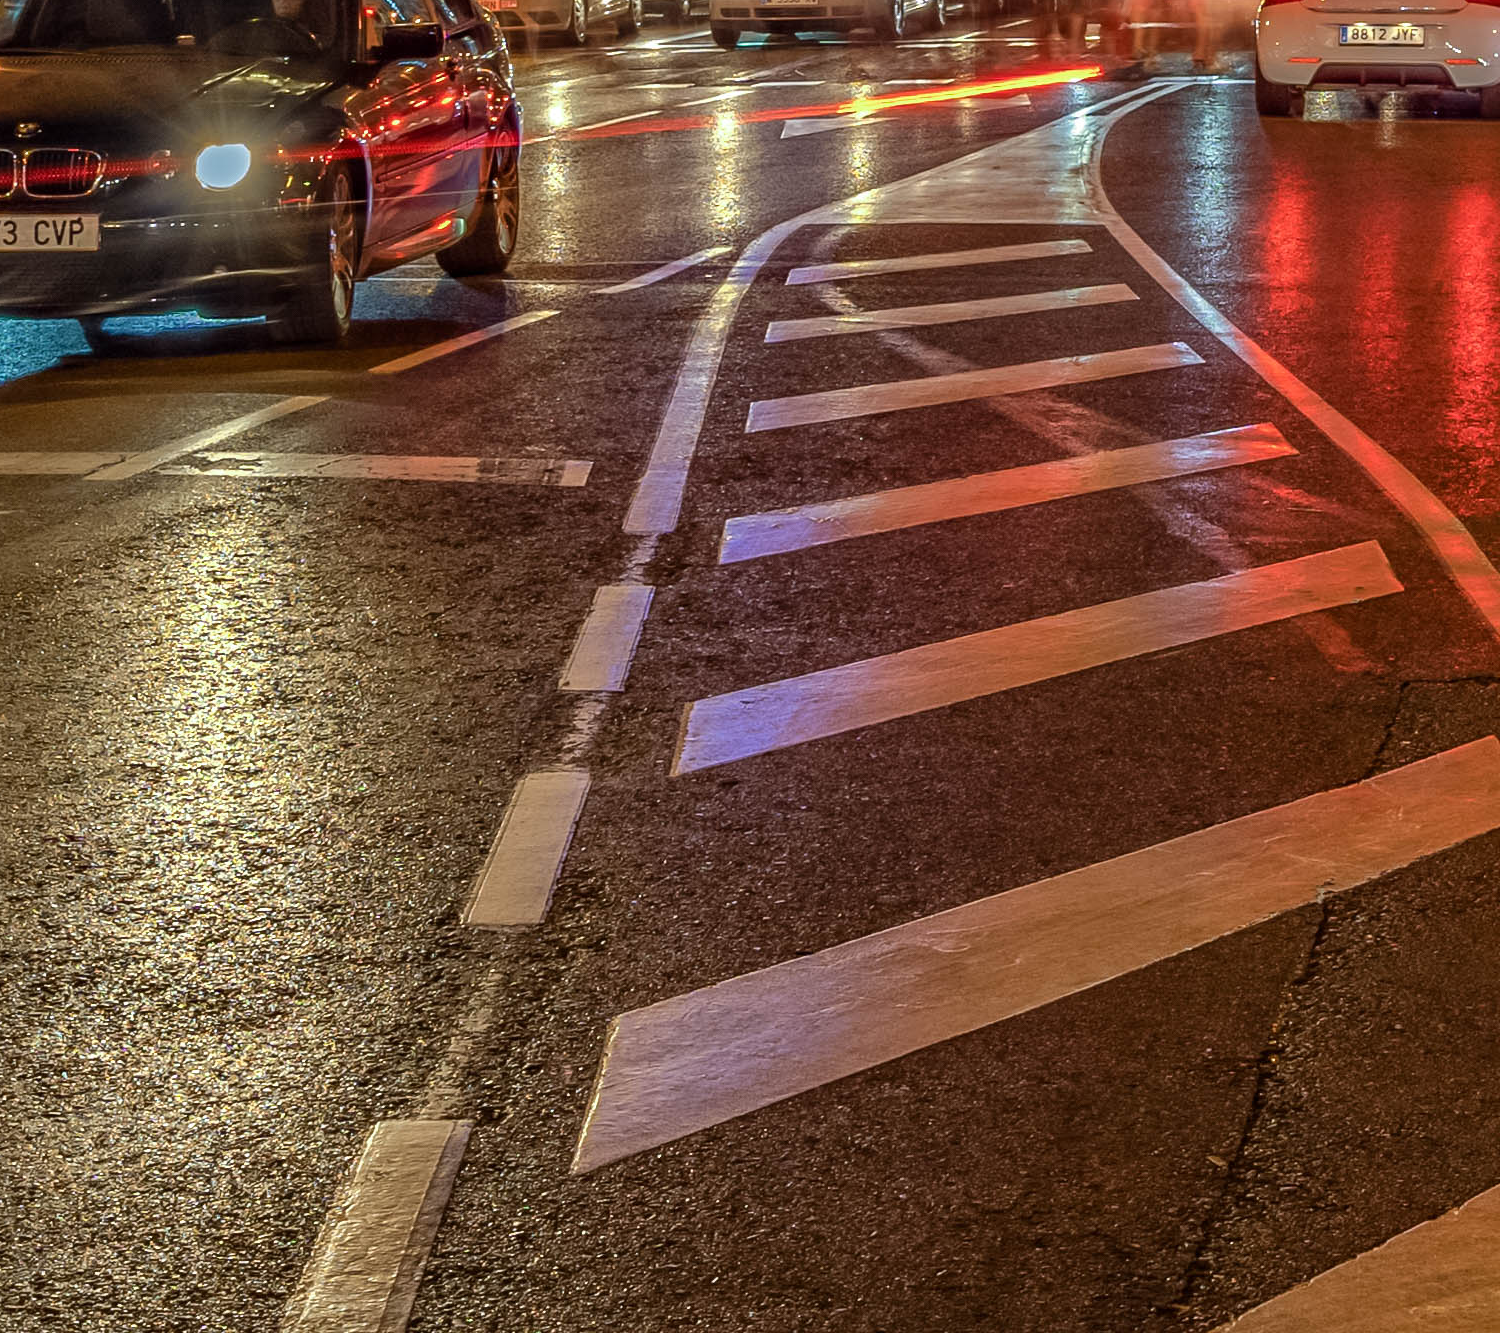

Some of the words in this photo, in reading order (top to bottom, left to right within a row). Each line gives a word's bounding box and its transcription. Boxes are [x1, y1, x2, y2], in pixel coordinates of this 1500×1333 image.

[1351, 28, 1387, 41] 8812
[1392, 28, 1418, 41] JYF
[34, 218, 84, 246] CVP
